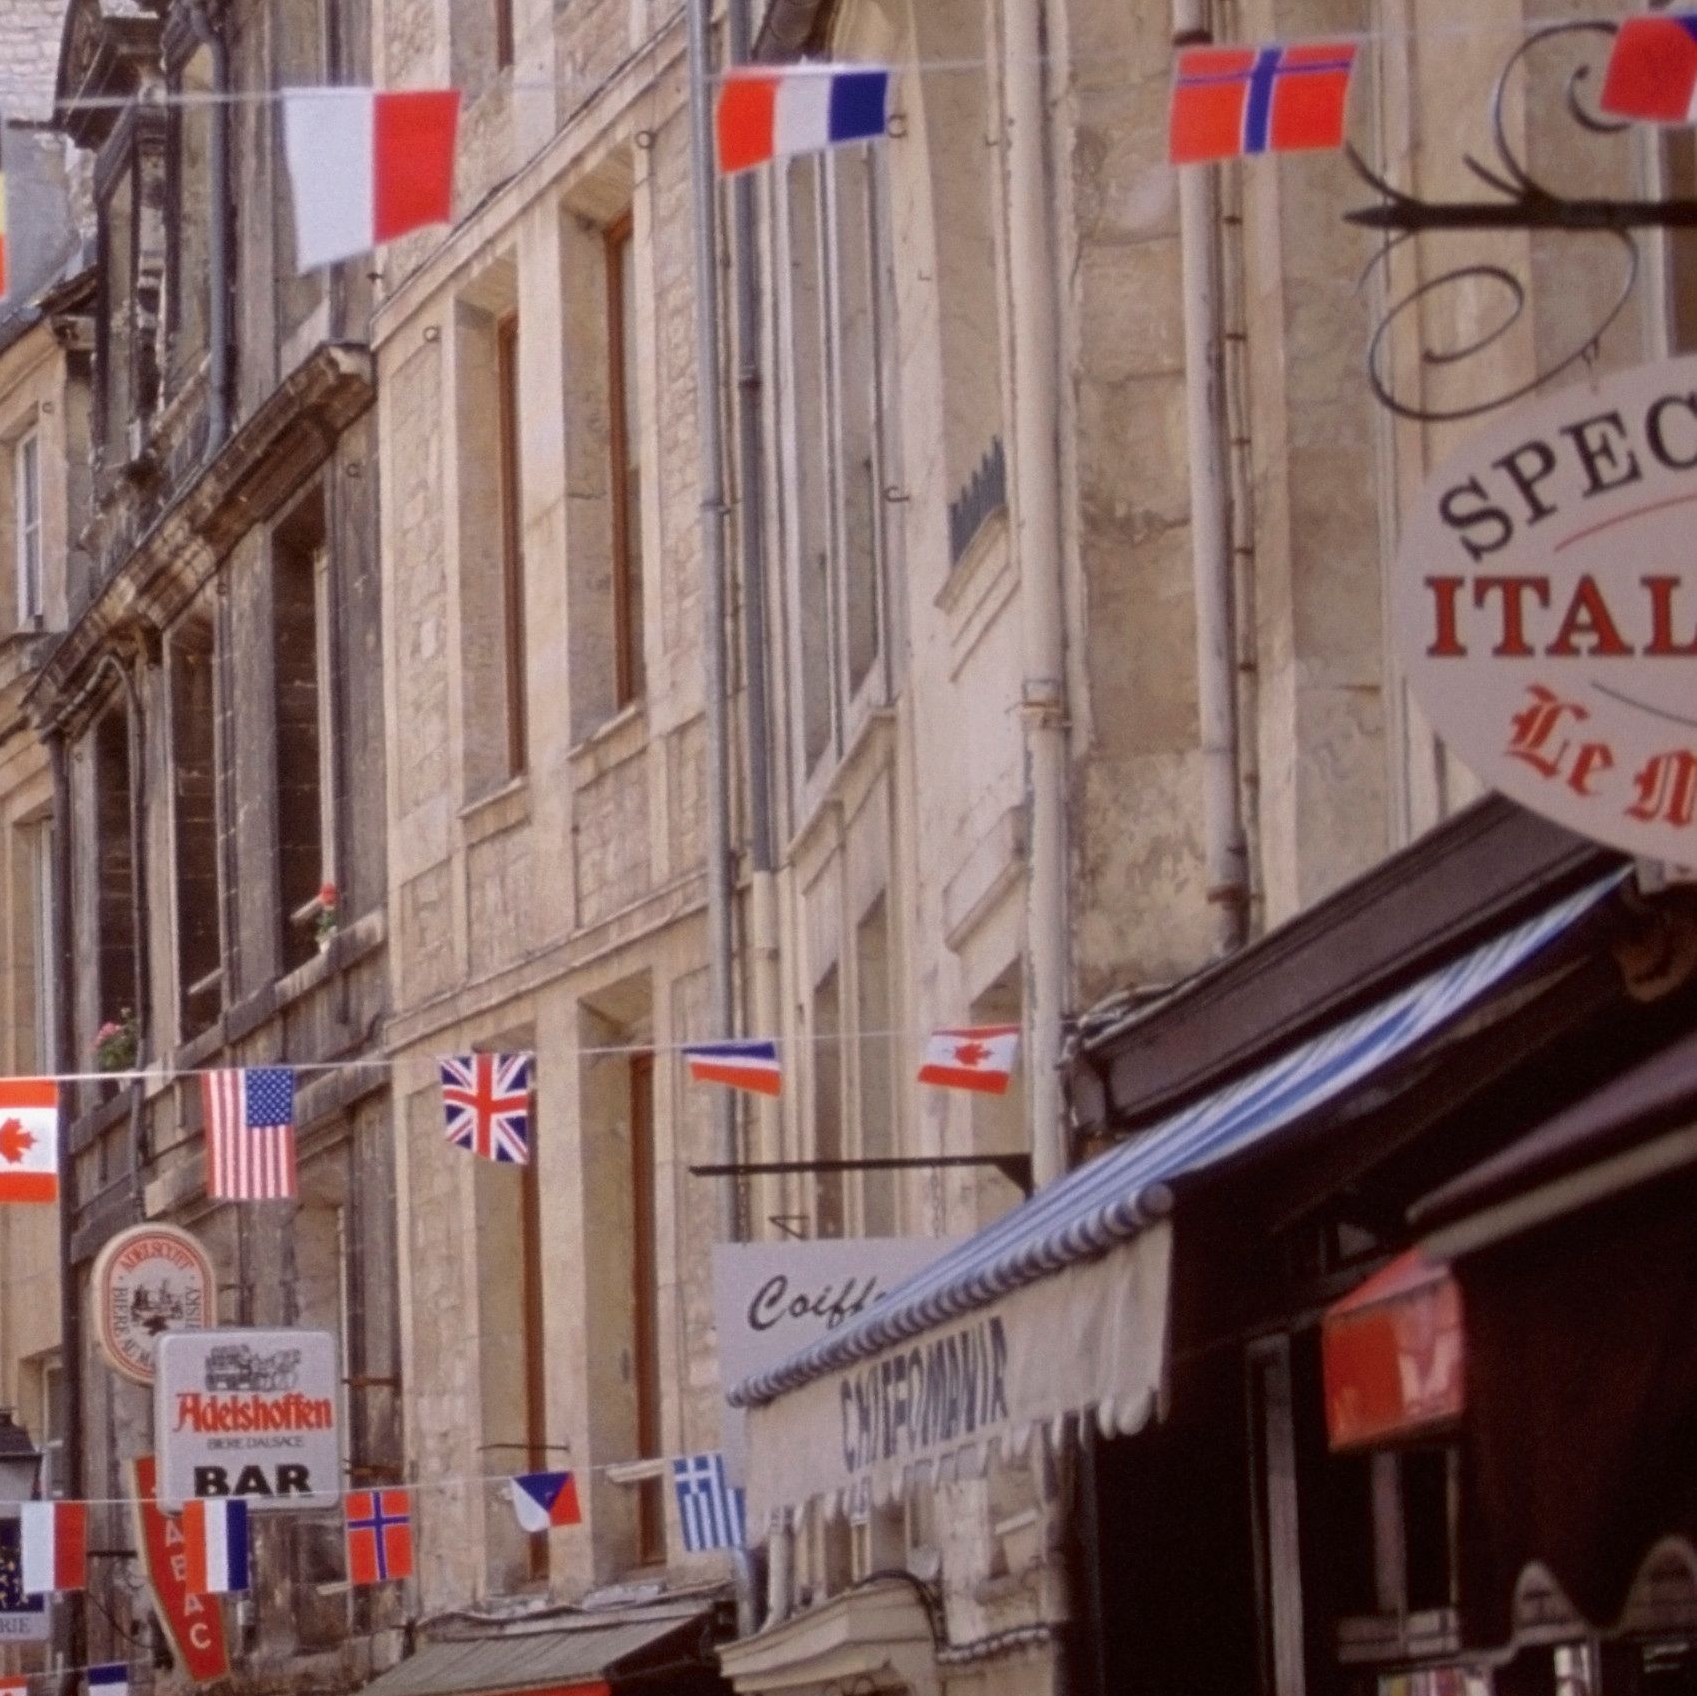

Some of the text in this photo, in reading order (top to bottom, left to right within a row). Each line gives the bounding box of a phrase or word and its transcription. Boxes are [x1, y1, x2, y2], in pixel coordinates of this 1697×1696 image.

[747, 1273, 888, 1332] Coiff
[172, 1391, 332, 1433] Adelshoffen
[193, 1463, 314, 1498] BAR
[164, 1517, 212, 1650] ABAC
